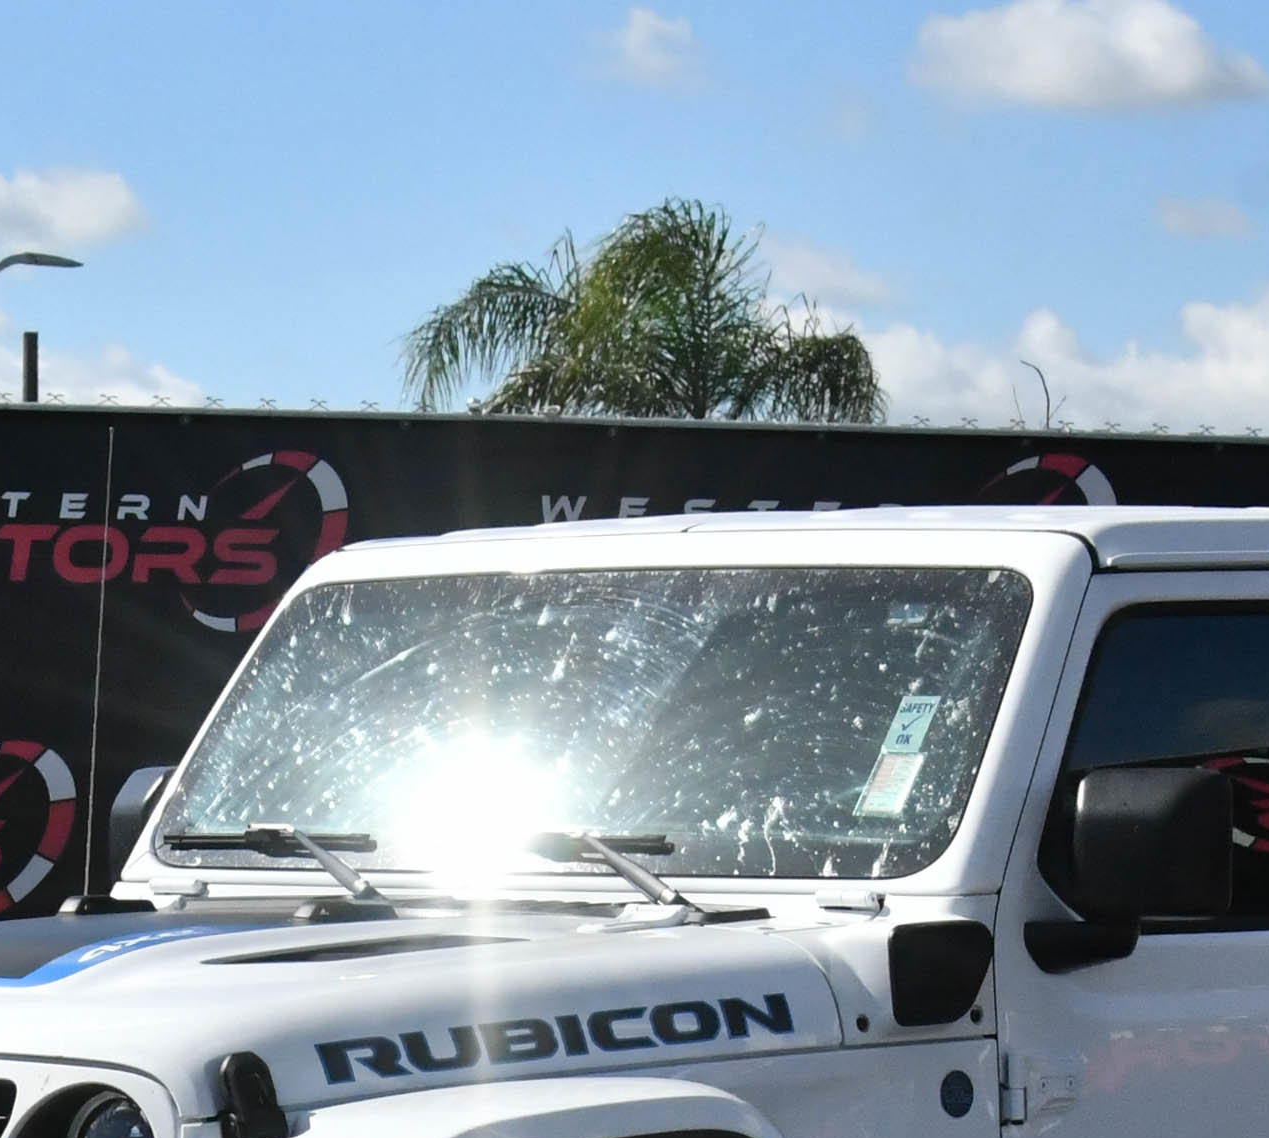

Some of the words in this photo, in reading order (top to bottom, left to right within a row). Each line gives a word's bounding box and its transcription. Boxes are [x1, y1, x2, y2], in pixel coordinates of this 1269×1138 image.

[899, 702, 935, 714] SAFETY
[895, 734, 912, 745] OK
[313, 992, 796, 1085] RUBICON
